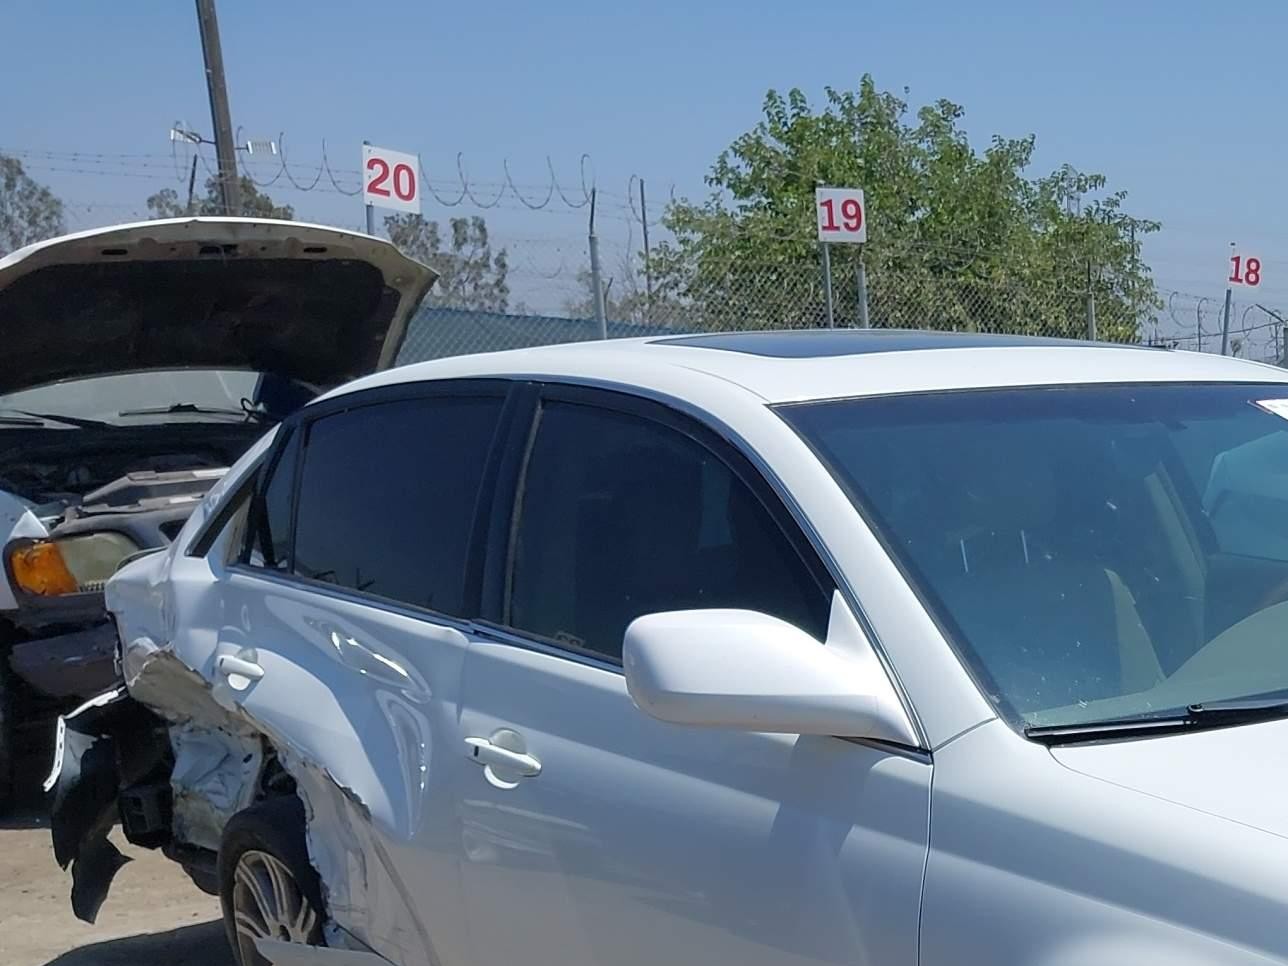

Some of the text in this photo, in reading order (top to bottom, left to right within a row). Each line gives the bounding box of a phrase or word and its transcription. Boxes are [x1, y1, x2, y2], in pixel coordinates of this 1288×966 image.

[366, 157, 416, 202] 20
[820, 198, 862, 233] 19
[1229, 255, 1261, 286] 18
